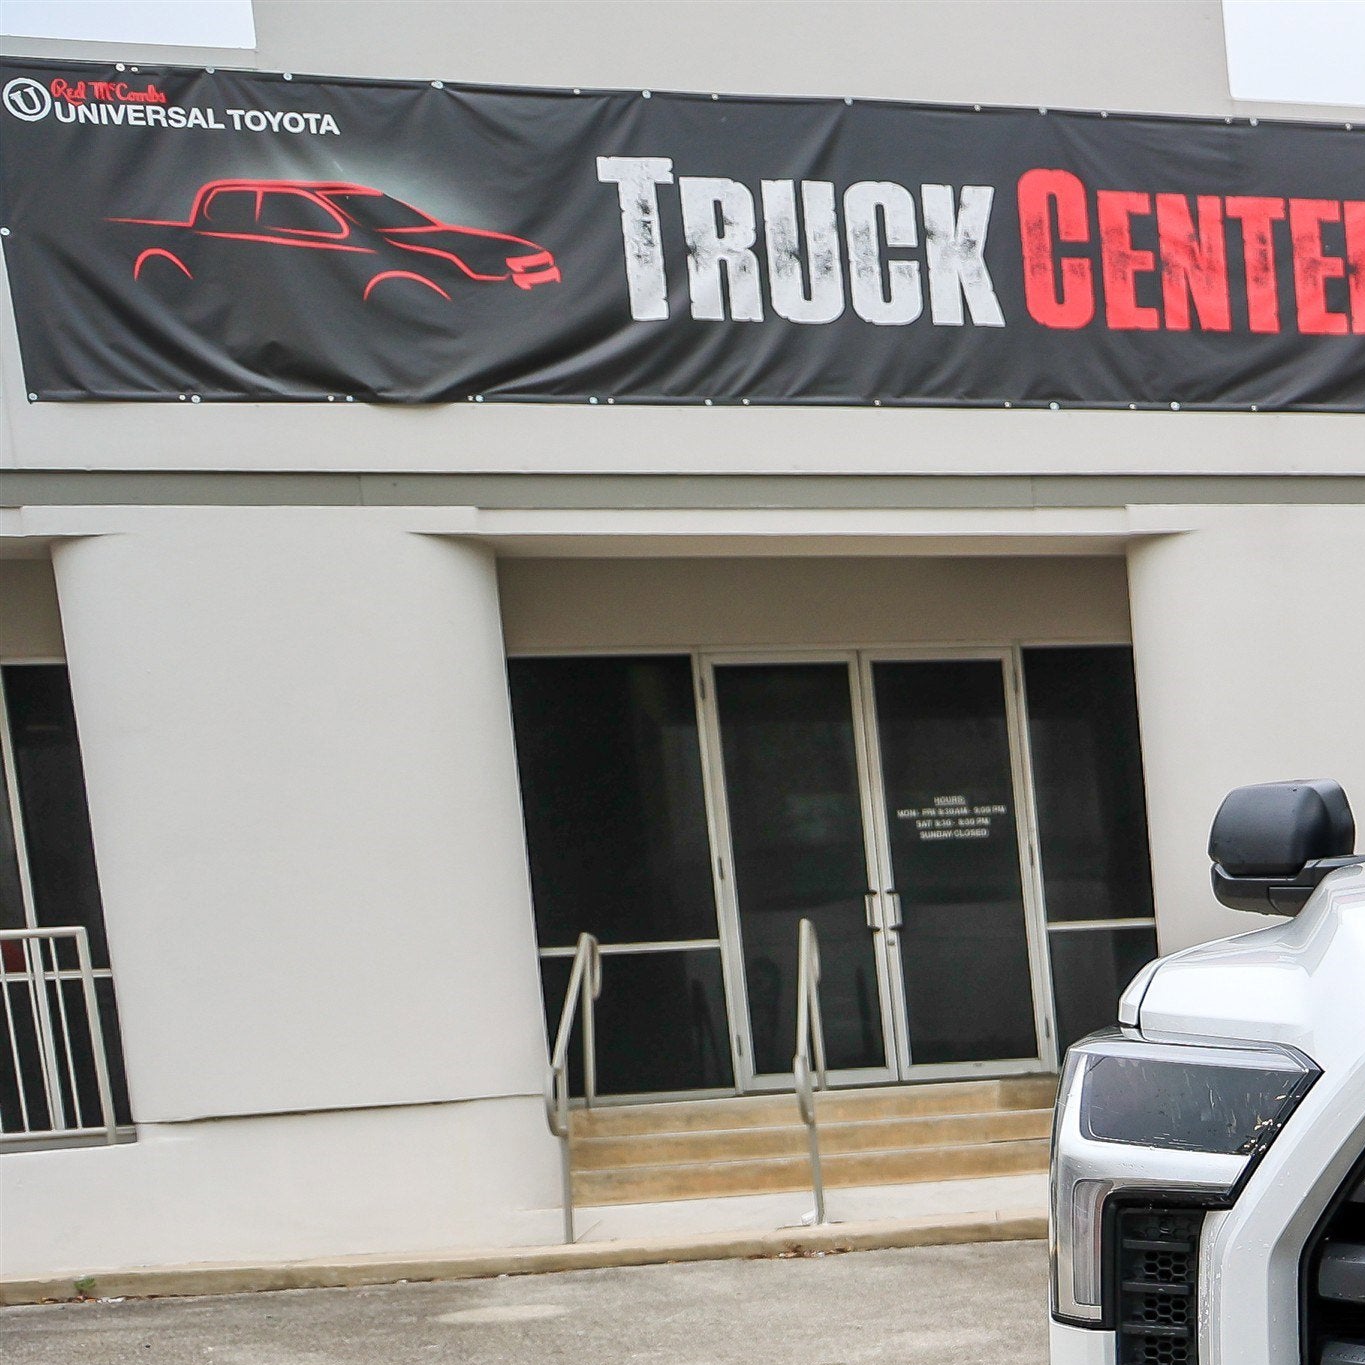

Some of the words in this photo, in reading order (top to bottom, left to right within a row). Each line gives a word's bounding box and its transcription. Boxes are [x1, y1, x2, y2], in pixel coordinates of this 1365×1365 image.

[51, 78, 86, 106] Red
[88, 81, 167, 104] McCombs
[54, 101, 225, 130] UNIVERSAL
[226, 109, 340, 135] TOYOTA
[596, 155, 1006, 328] TRUCK
[920, 830, 952, 839] SUNDAY
[953, 828, 987, 837] CLOSED
